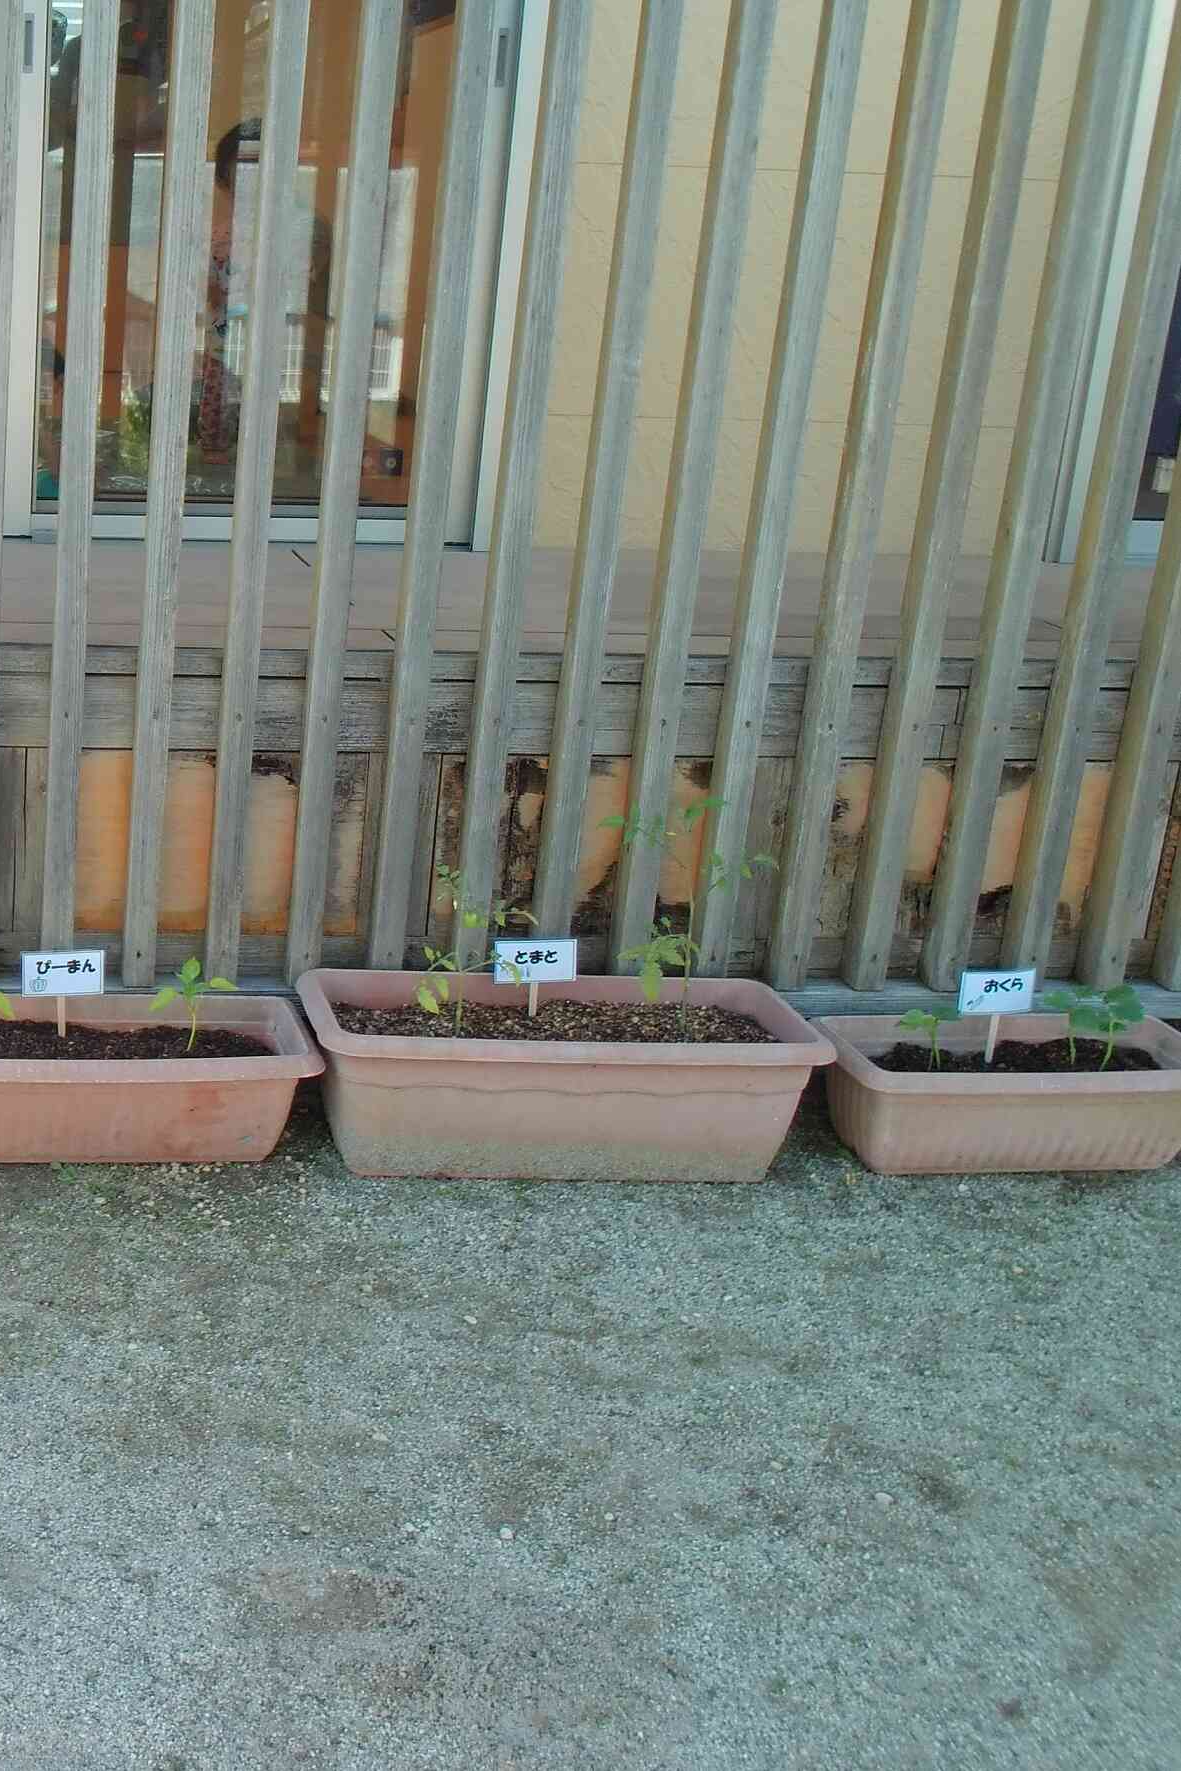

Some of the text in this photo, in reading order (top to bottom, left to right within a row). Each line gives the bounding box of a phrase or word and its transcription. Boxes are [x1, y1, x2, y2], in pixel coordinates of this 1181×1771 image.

[515, 949, 558, 964] とまと
[36, 959, 96, 974] ぴーまん
[984, 977, 1023, 993] おくら
